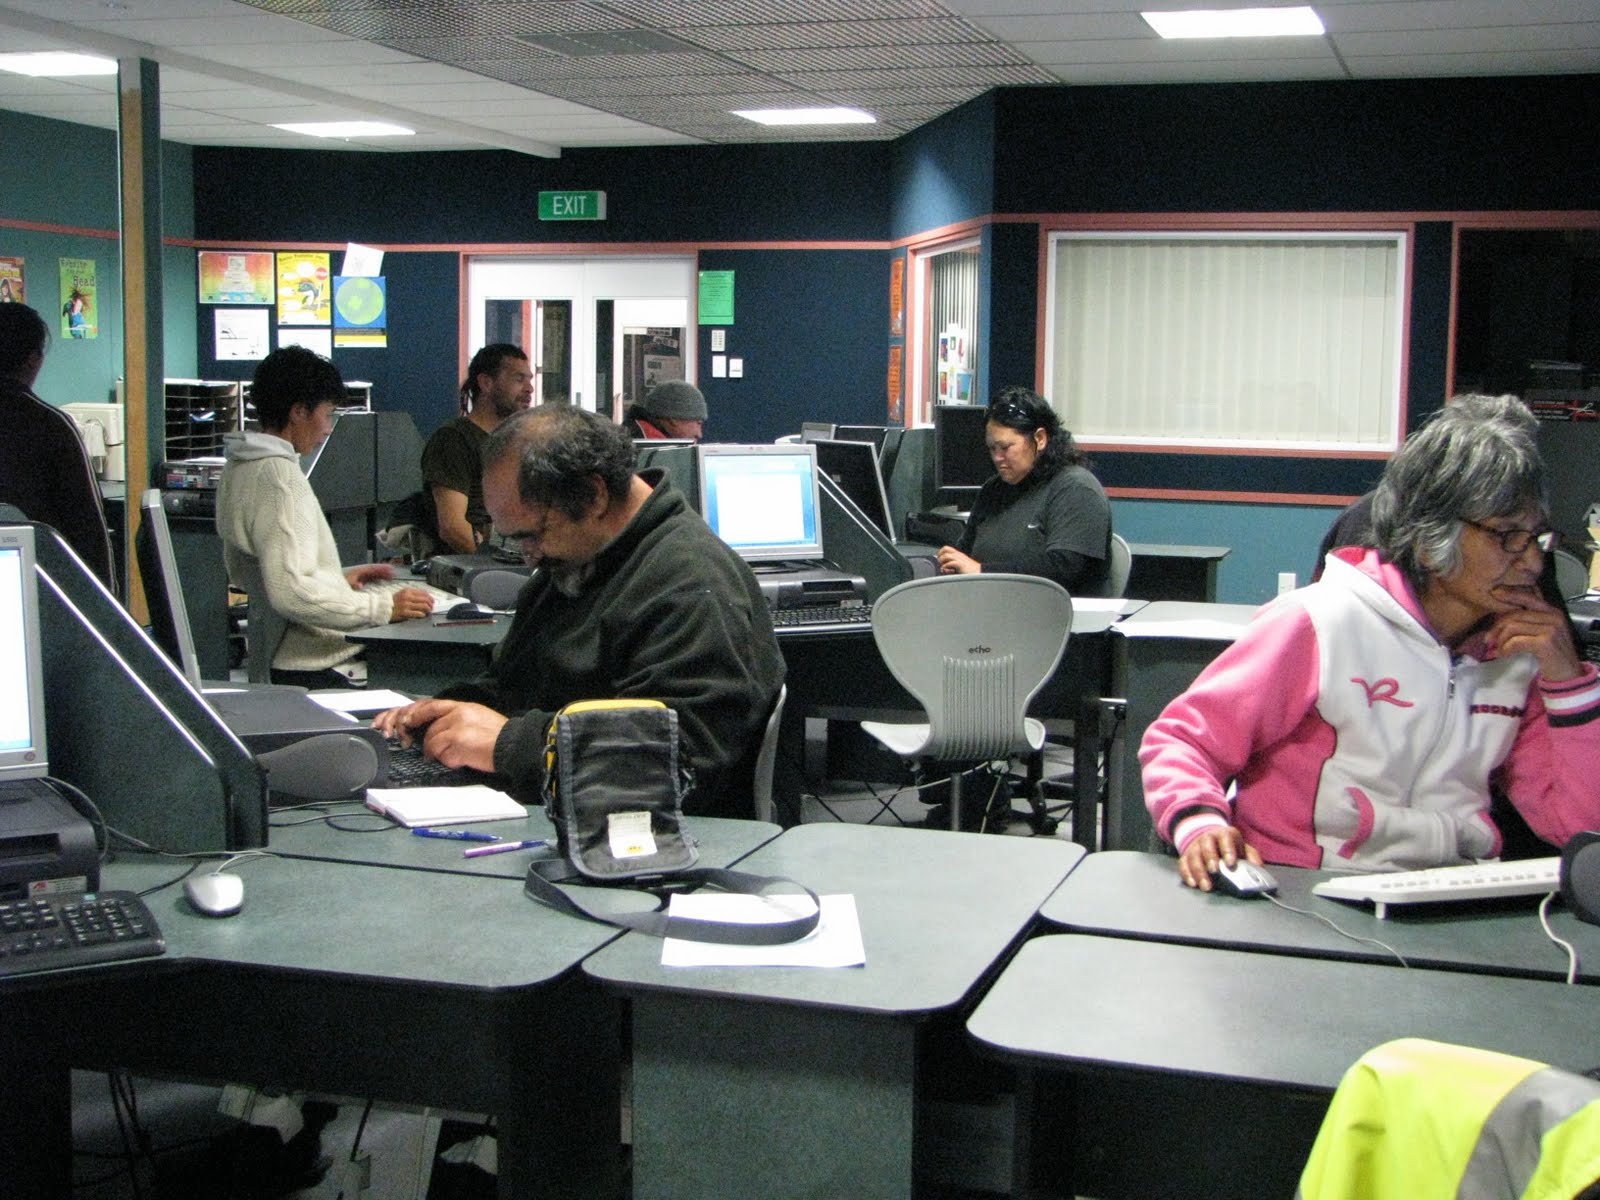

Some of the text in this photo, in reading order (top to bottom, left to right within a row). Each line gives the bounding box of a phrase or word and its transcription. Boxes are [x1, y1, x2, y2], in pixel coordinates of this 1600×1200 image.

[553, 196, 587, 215] EXIT
[968, 644, 991, 654] echo
[1350, 677, 1414, 708] R
